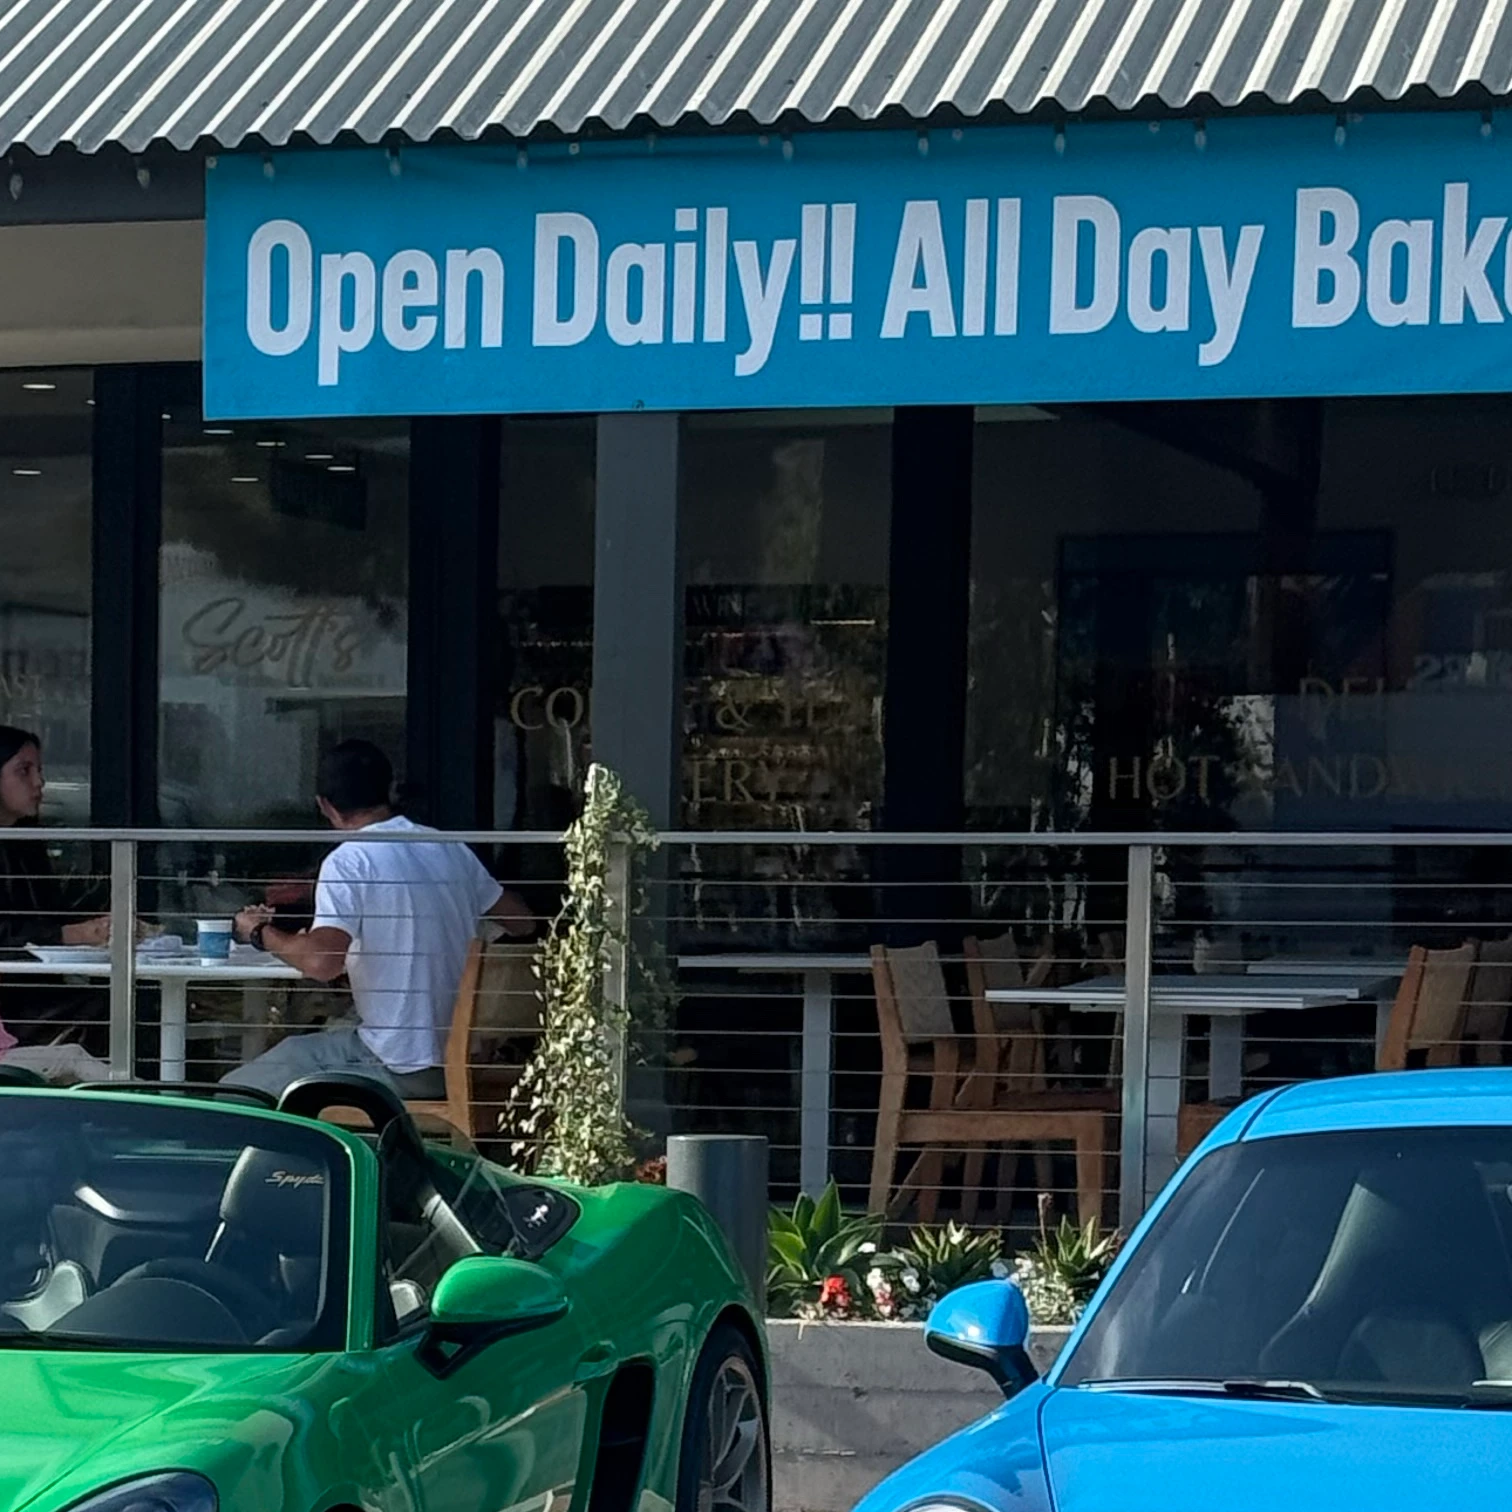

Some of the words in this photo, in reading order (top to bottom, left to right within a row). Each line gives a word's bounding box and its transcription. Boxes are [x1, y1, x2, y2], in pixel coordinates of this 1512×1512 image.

[246, 219, 504, 385] Open
[532, 203, 856, 376] Daily!!
[879, 198, 1021, 338] All
[1049, 195, 1265, 366] Day
[1109, 755, 1220, 800] HOT
